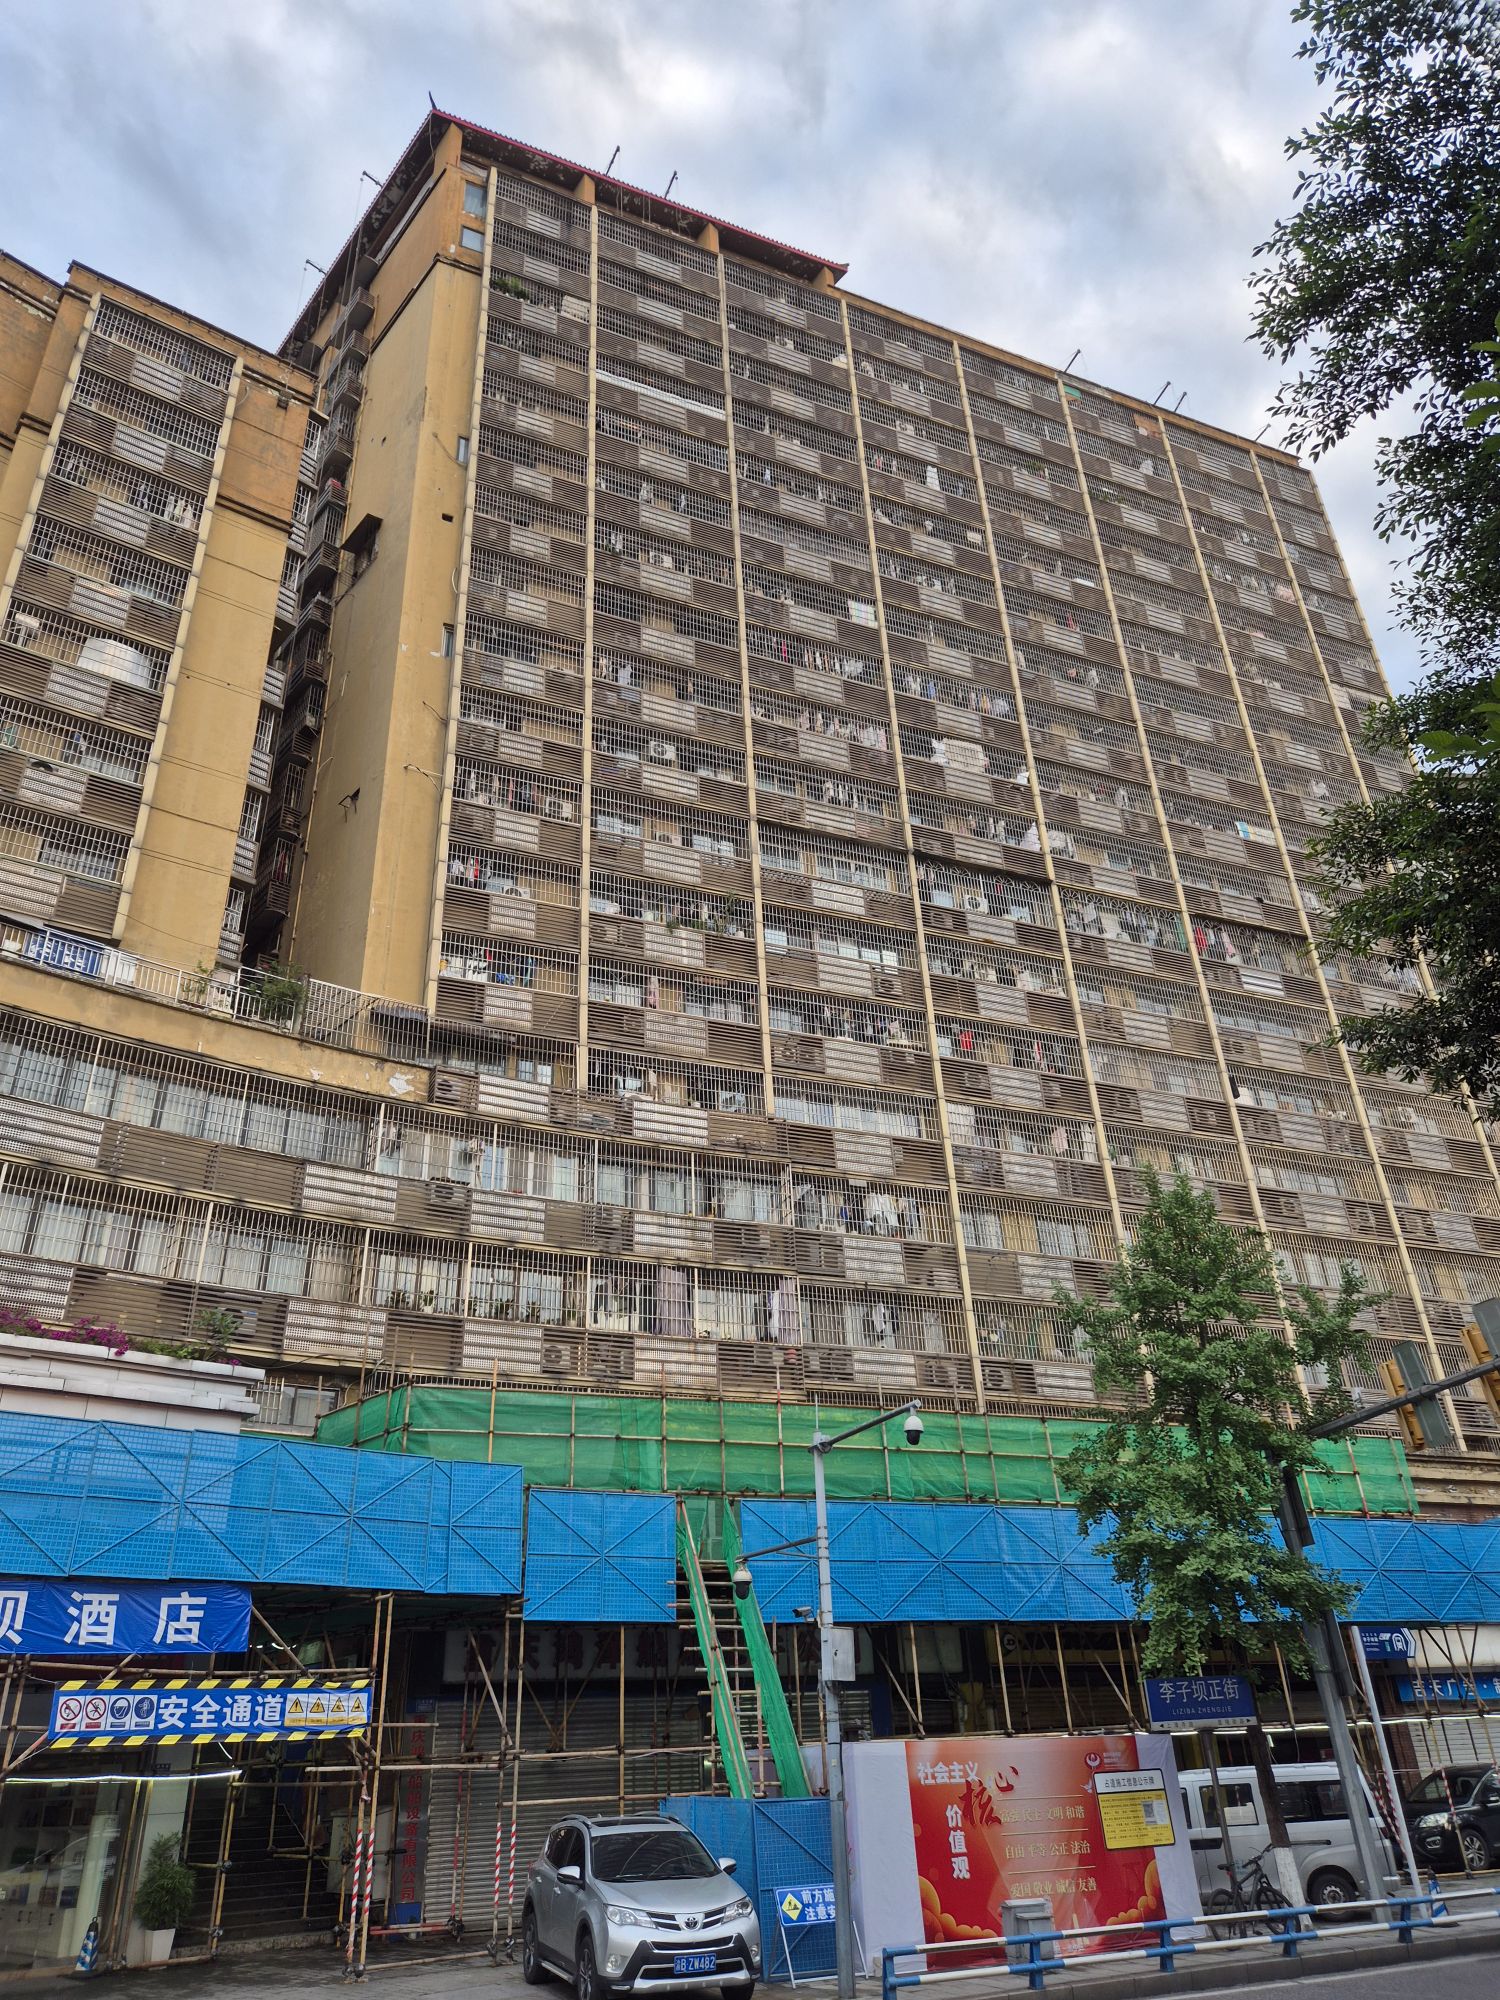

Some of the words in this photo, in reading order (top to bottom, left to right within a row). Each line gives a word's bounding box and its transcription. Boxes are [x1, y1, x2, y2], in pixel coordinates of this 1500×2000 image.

[1159, 1678, 1239, 1703] 李子坝正街
[157, 1694, 284, 1729] 安全通道
[1198, 1706, 1233, 1714] ZHENGJIE
[917, 1761, 979, 1785] 社会主义
[1023, 1807, 1041, 1822] 民主
[1048, 1805, 1064, 1820] 文明
[1066, 1804, 1085, 1819] 和谐
[945, 1804, 971, 1880] 价值观
[1006, 1845, 1025, 1859] 自由
[1030, 1843, 1047, 1857] 平等
[1050, 1841, 1069, 1856] 公正
[1071, 1840, 1091, 1855] 法治
[1011, 1882, 1032, 1897] 爱国
[1034, 1880, 1053, 1895] 敬业
[1057, 1878, 1075, 1893] 诚信
[1078, 1876, 1097, 1892] 友善
